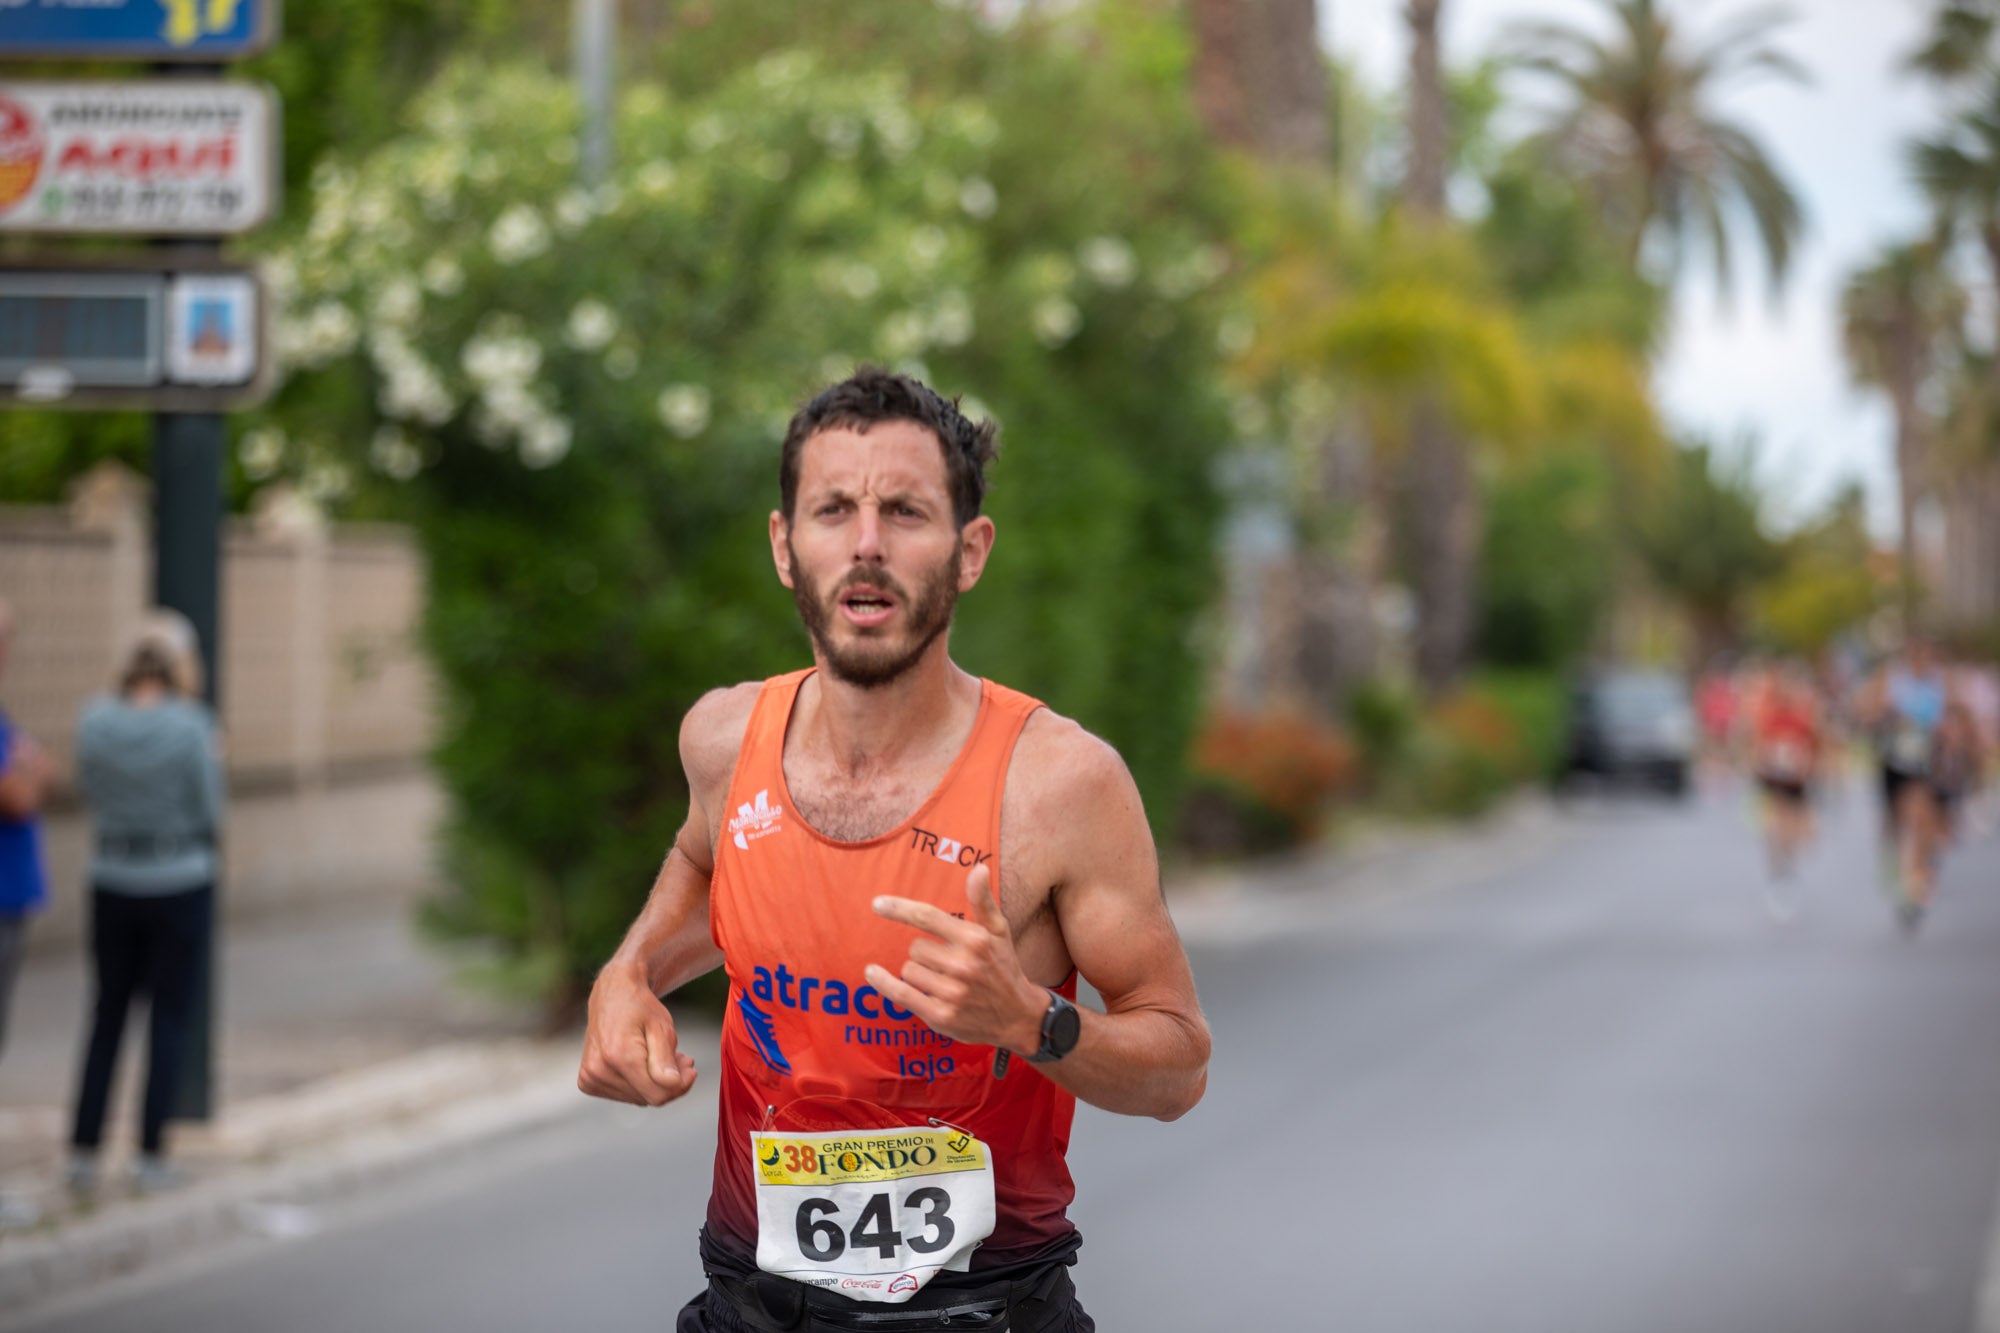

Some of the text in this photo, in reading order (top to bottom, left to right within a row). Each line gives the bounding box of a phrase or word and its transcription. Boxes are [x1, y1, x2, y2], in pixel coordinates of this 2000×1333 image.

[912, 826, 992, 866] TRACK
[845, 1024, 953, 1048] running
[900, 1054, 954, 1082] loja
[822, 1142, 863, 1153] GRAN
[867, 1136, 923, 1151] PREMIO
[783, 1145, 818, 1173] 38
[818, 1145, 936, 1175] FONDO
[795, 1186, 955, 1262] 643
